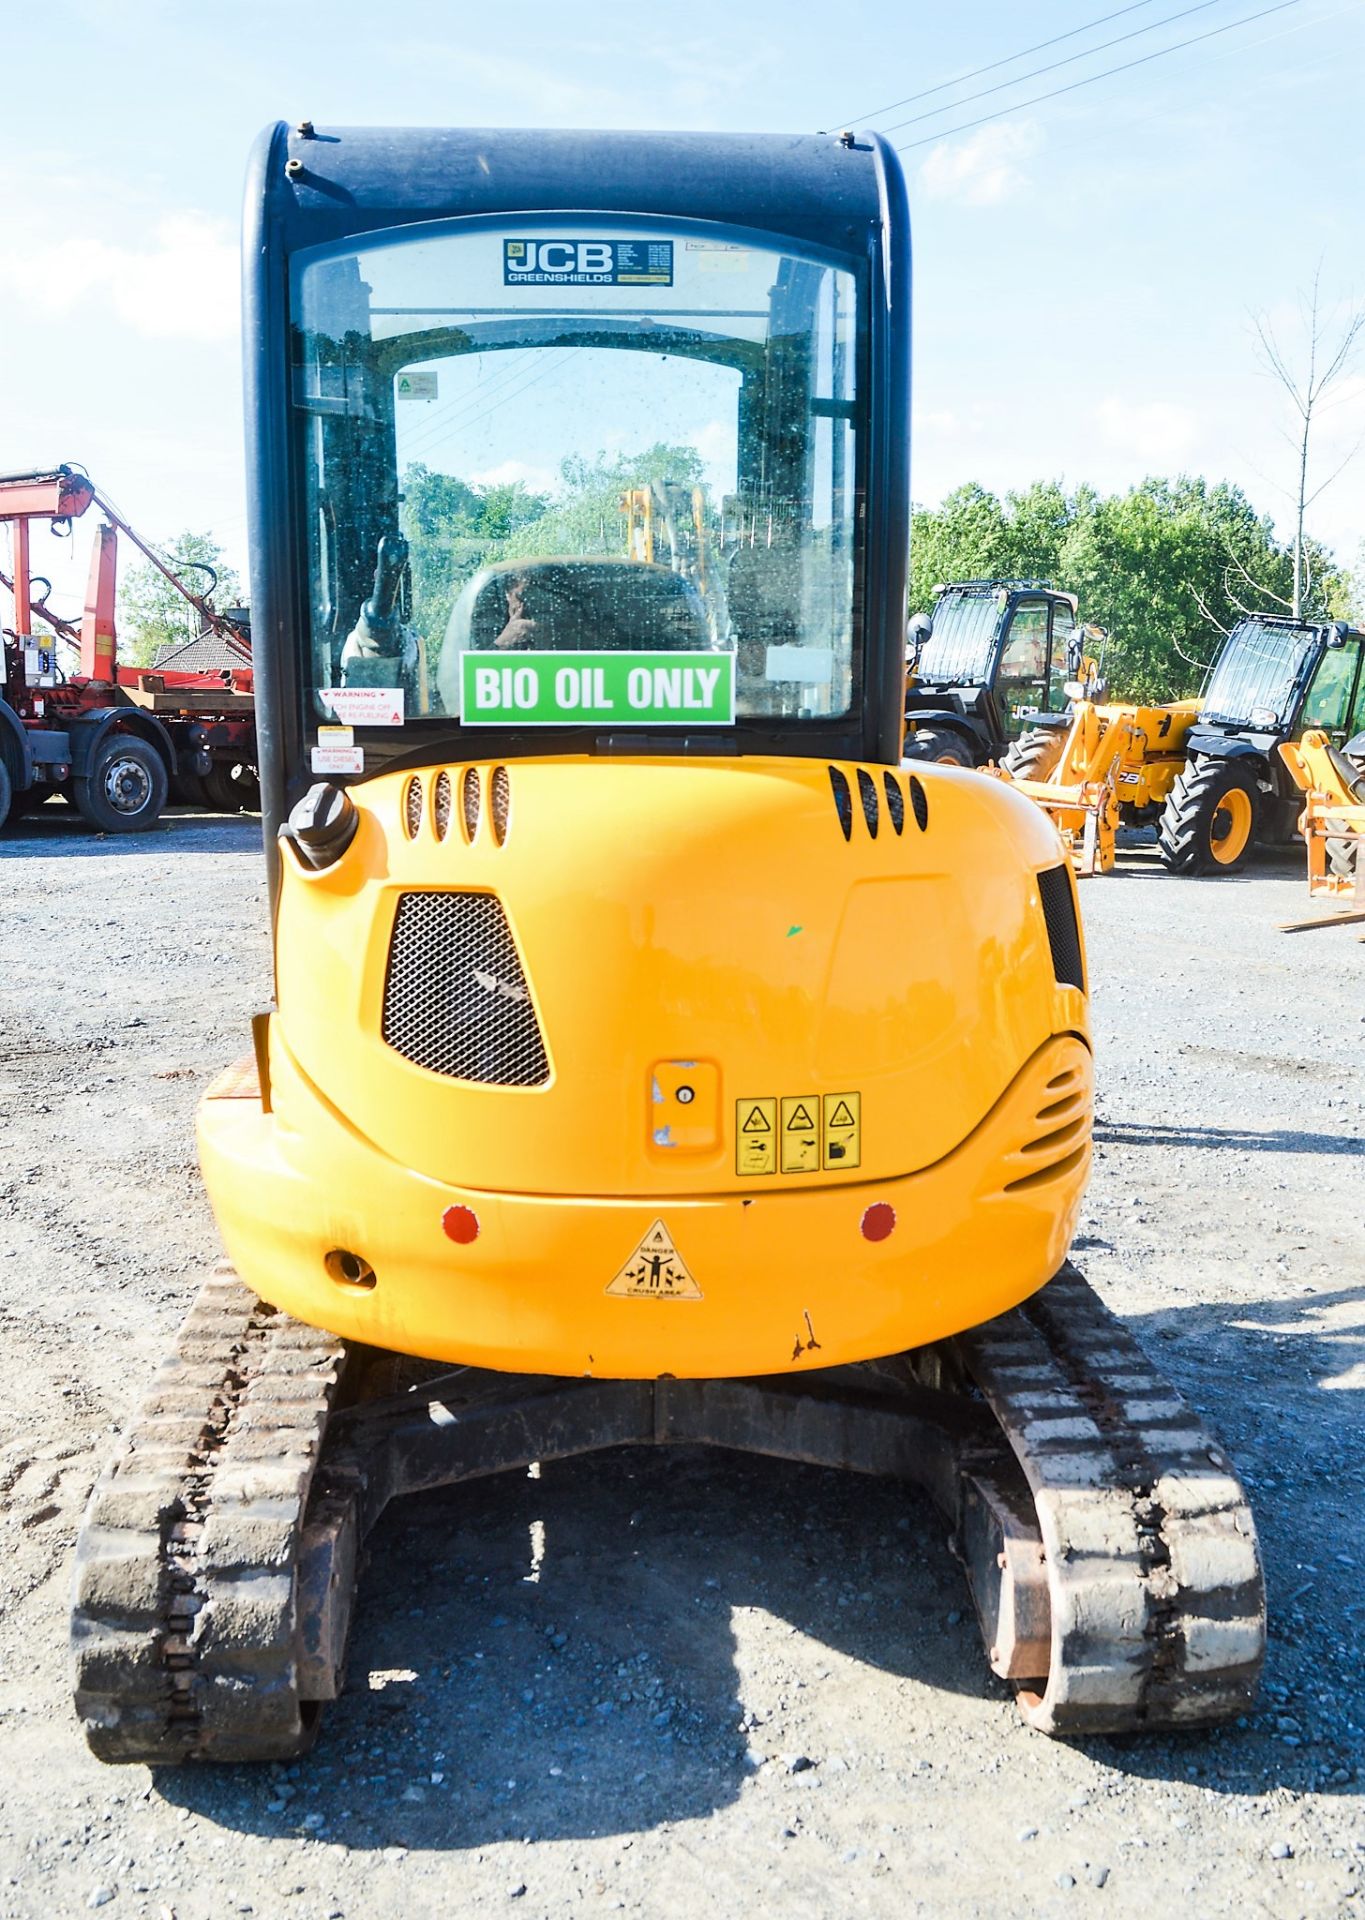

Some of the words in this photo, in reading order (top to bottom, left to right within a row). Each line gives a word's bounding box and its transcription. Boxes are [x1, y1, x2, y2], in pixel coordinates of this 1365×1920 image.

[507, 242, 613, 273] JCB
[508, 273, 613, 283] GREENSHIELDS
[475, 667, 539, 709] BIO
[555, 667, 614, 709] OIL
[627, 667, 721, 709] ONLY
[640, 1246, 675, 1254] DANGER
[626, 1287, 657, 1295] CRUSH
